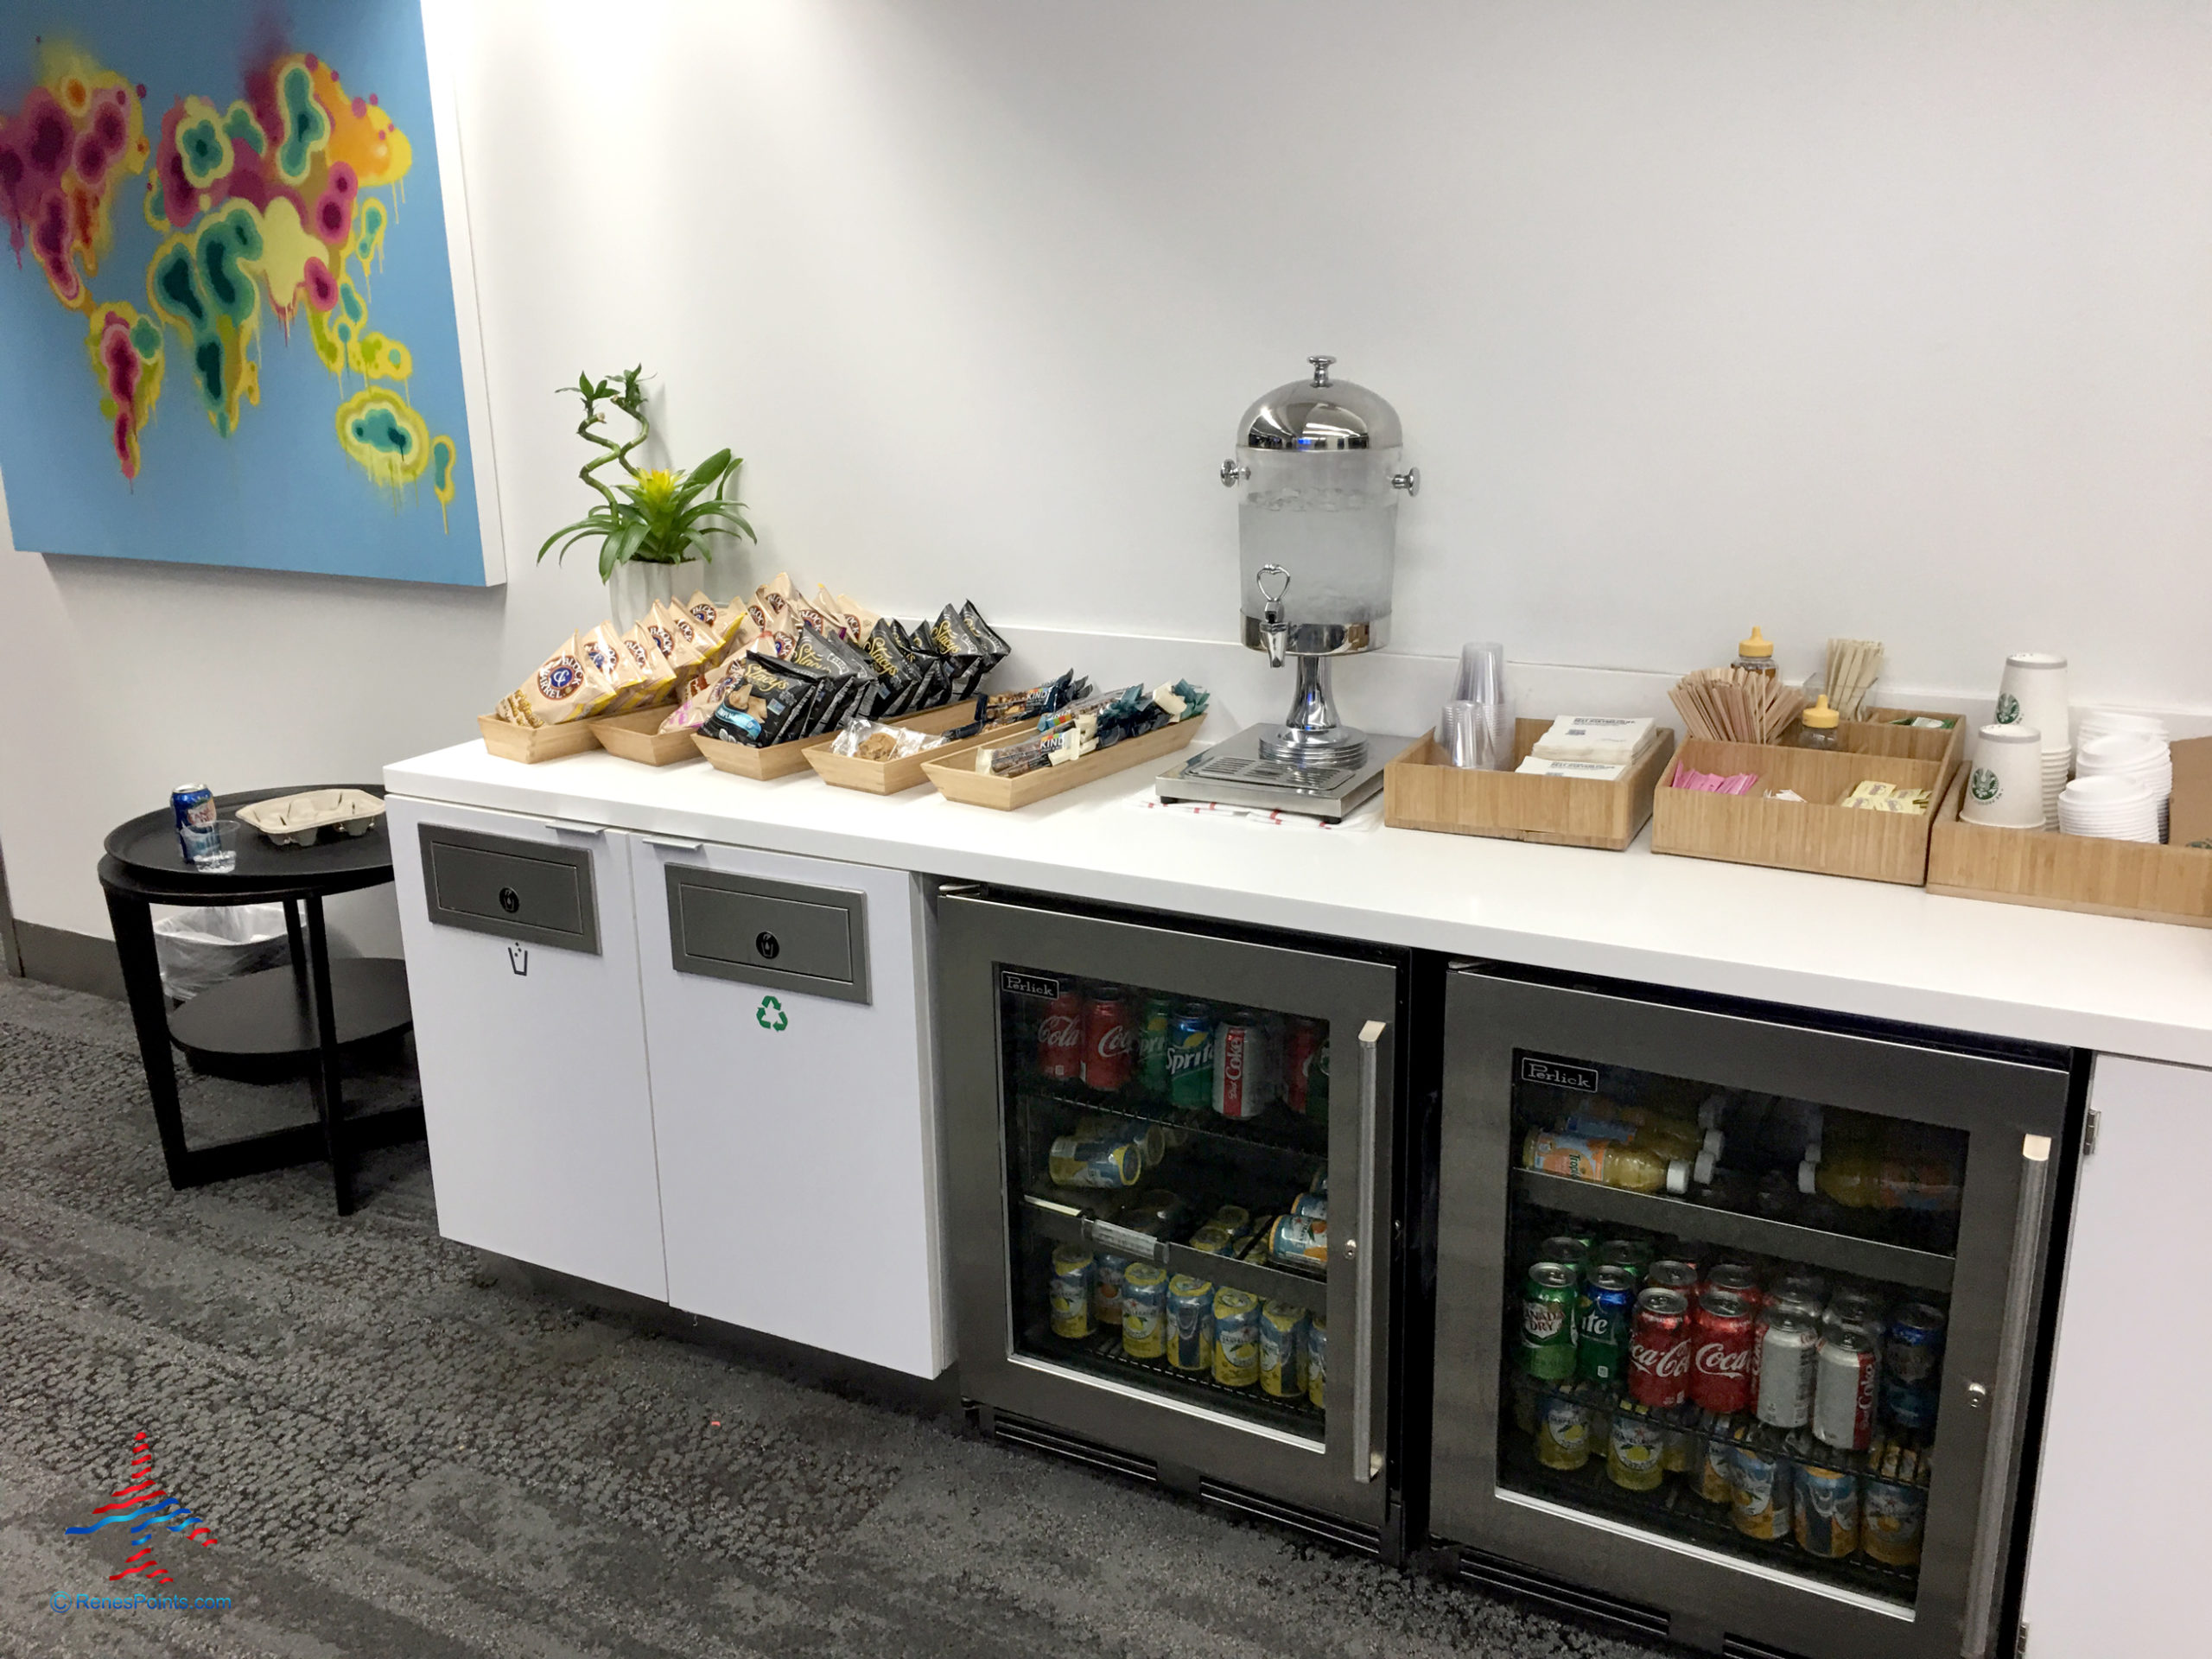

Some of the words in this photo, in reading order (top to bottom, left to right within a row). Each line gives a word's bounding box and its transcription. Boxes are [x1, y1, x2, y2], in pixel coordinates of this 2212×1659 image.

[692, 605, 715, 621] BLOCK
[768, 594, 784, 607] BLOC
[677, 619, 693, 642] LOCK
[799, 610, 822, 632] BLOCK
[650, 626, 672, 654] BLOCK
[930, 620, 962, 655] Stacy's
[626, 641, 645, 665] BLOC
[863, 637, 899, 676] Stacy's
[562, 657, 582, 685] BLOCK
[745, 664, 789, 691] Stacy's
[1027, 690, 1048, 701] KIND
[1040, 736, 1065, 749] KIND
[1006, 975, 1054, 996] Perlick
[1038, 1014, 1081, 1047] Cola
[1225, 1038, 1243, 1080] Coke
[1527, 1062, 1592, 1088] Perlick
[1529, 1320, 1554, 1332] DRY
[1581, 1309, 1608, 1335] ite
